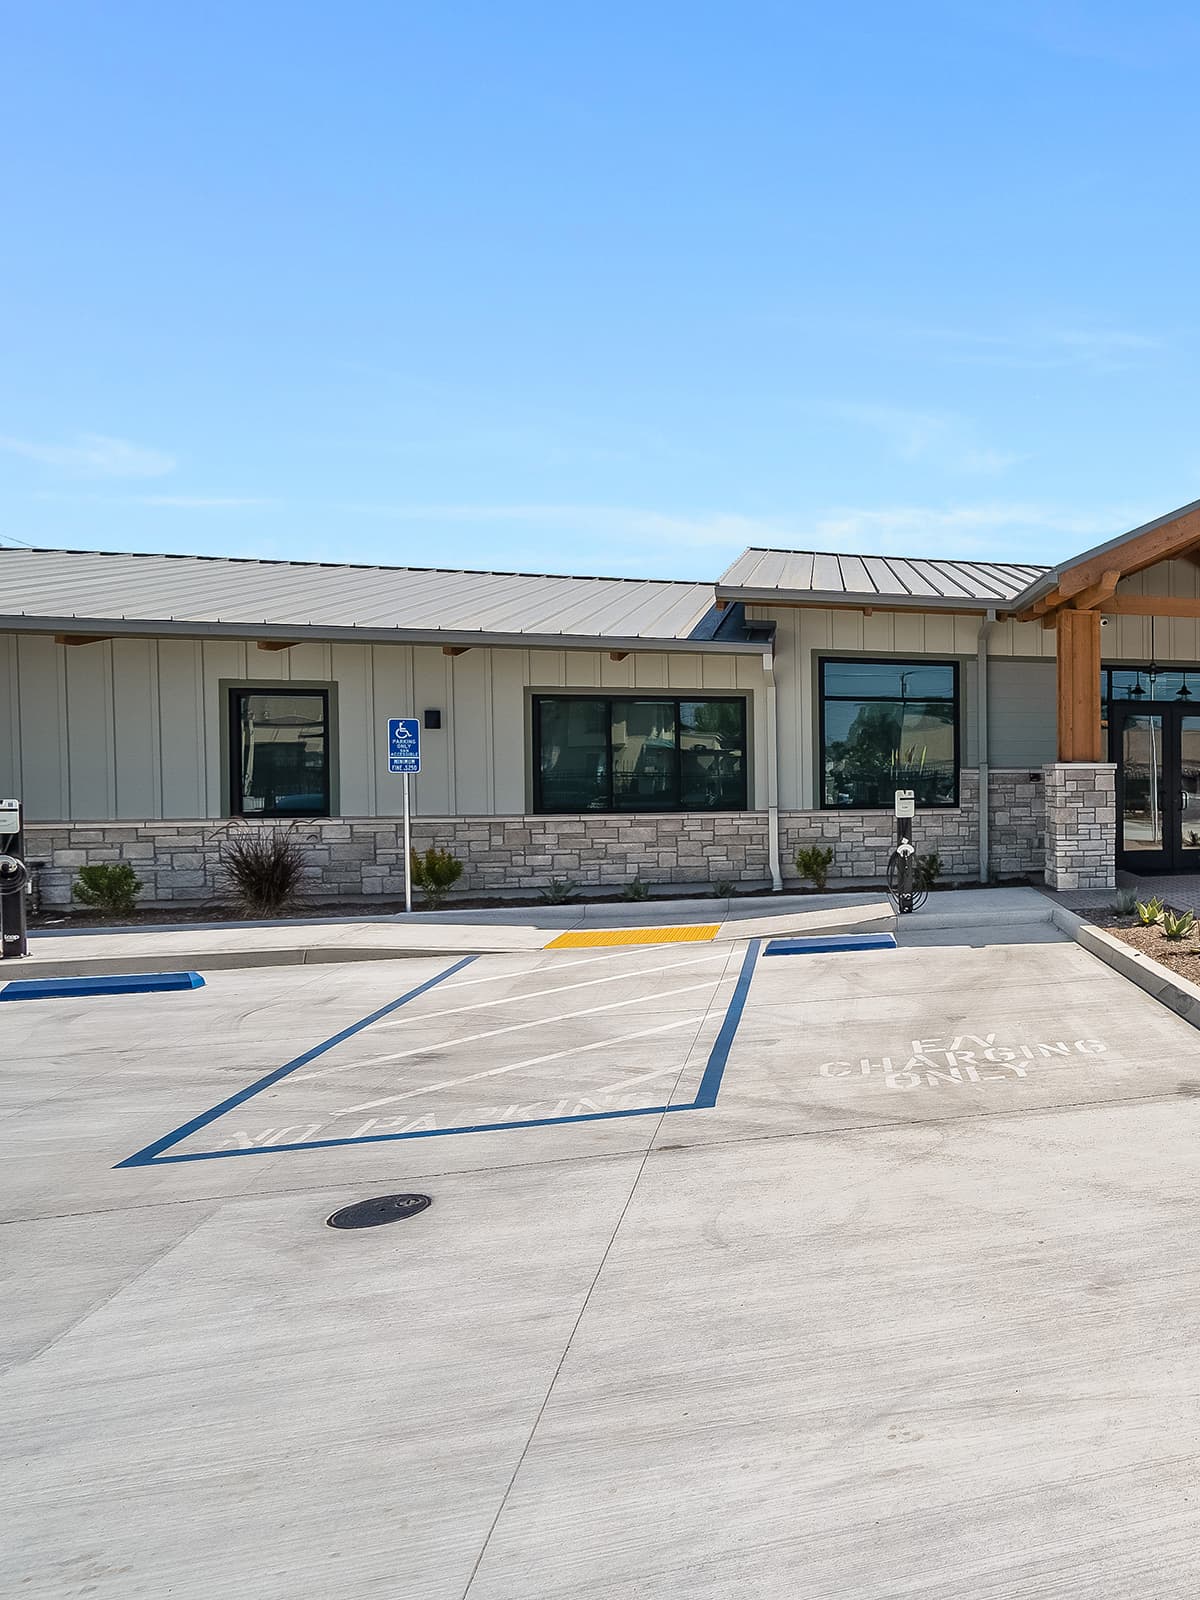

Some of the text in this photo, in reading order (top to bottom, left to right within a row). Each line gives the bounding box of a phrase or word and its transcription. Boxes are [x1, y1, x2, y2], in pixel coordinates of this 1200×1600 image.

[911, 1033, 996, 1054] EV
[818, 1039, 1108, 1078] CHARGING
[885, 1061, 1031, 1090] ONLY
